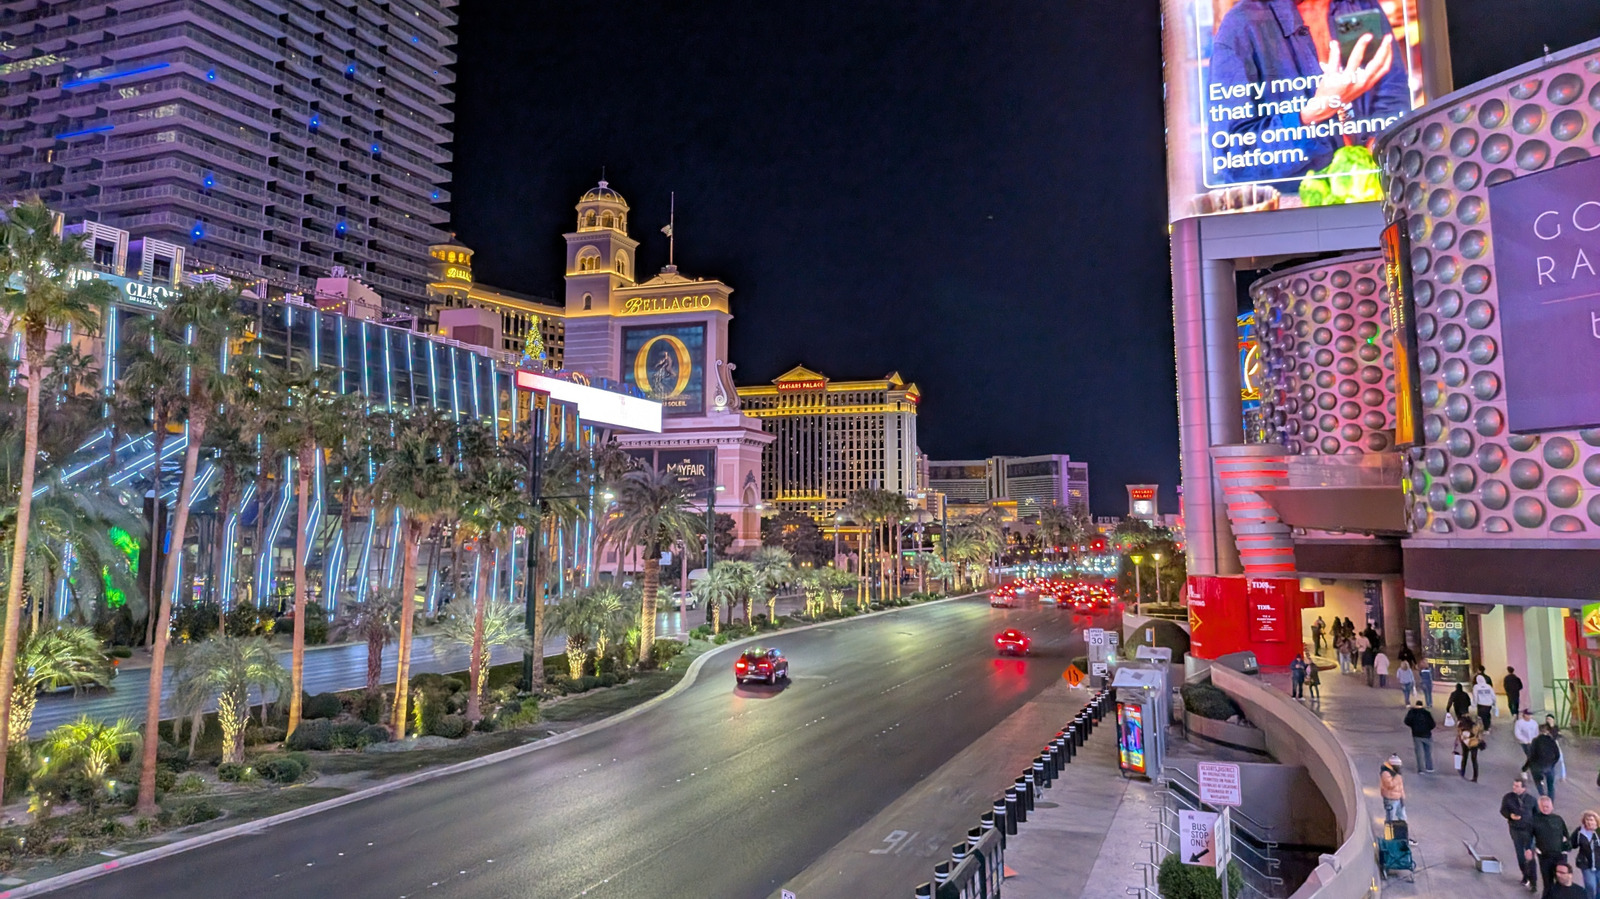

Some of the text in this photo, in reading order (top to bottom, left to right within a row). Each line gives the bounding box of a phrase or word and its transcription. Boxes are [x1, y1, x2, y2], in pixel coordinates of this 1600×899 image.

[1209, 67, 1365, 100] Every momnt
[1209, 94, 1346, 122] that matters.
[1211, 111, 1404, 148] One omnichanne
[1213, 148, 1309, 174] platform.
[1534, 201, 1600, 240] GO
[1537, 248, 1596, 285] RA
[126, 281, 183, 310] CLIQ
[621, 294, 711, 314] BELLAGIO
[778, 381, 824, 390] CAESARS PALACE
[666, 463, 706, 477] MAYFAIR
[1190, 831, 1209, 840] STOP
[1191, 823, 1207, 831] BUS
[1190, 838, 1209, 848] ONLY
